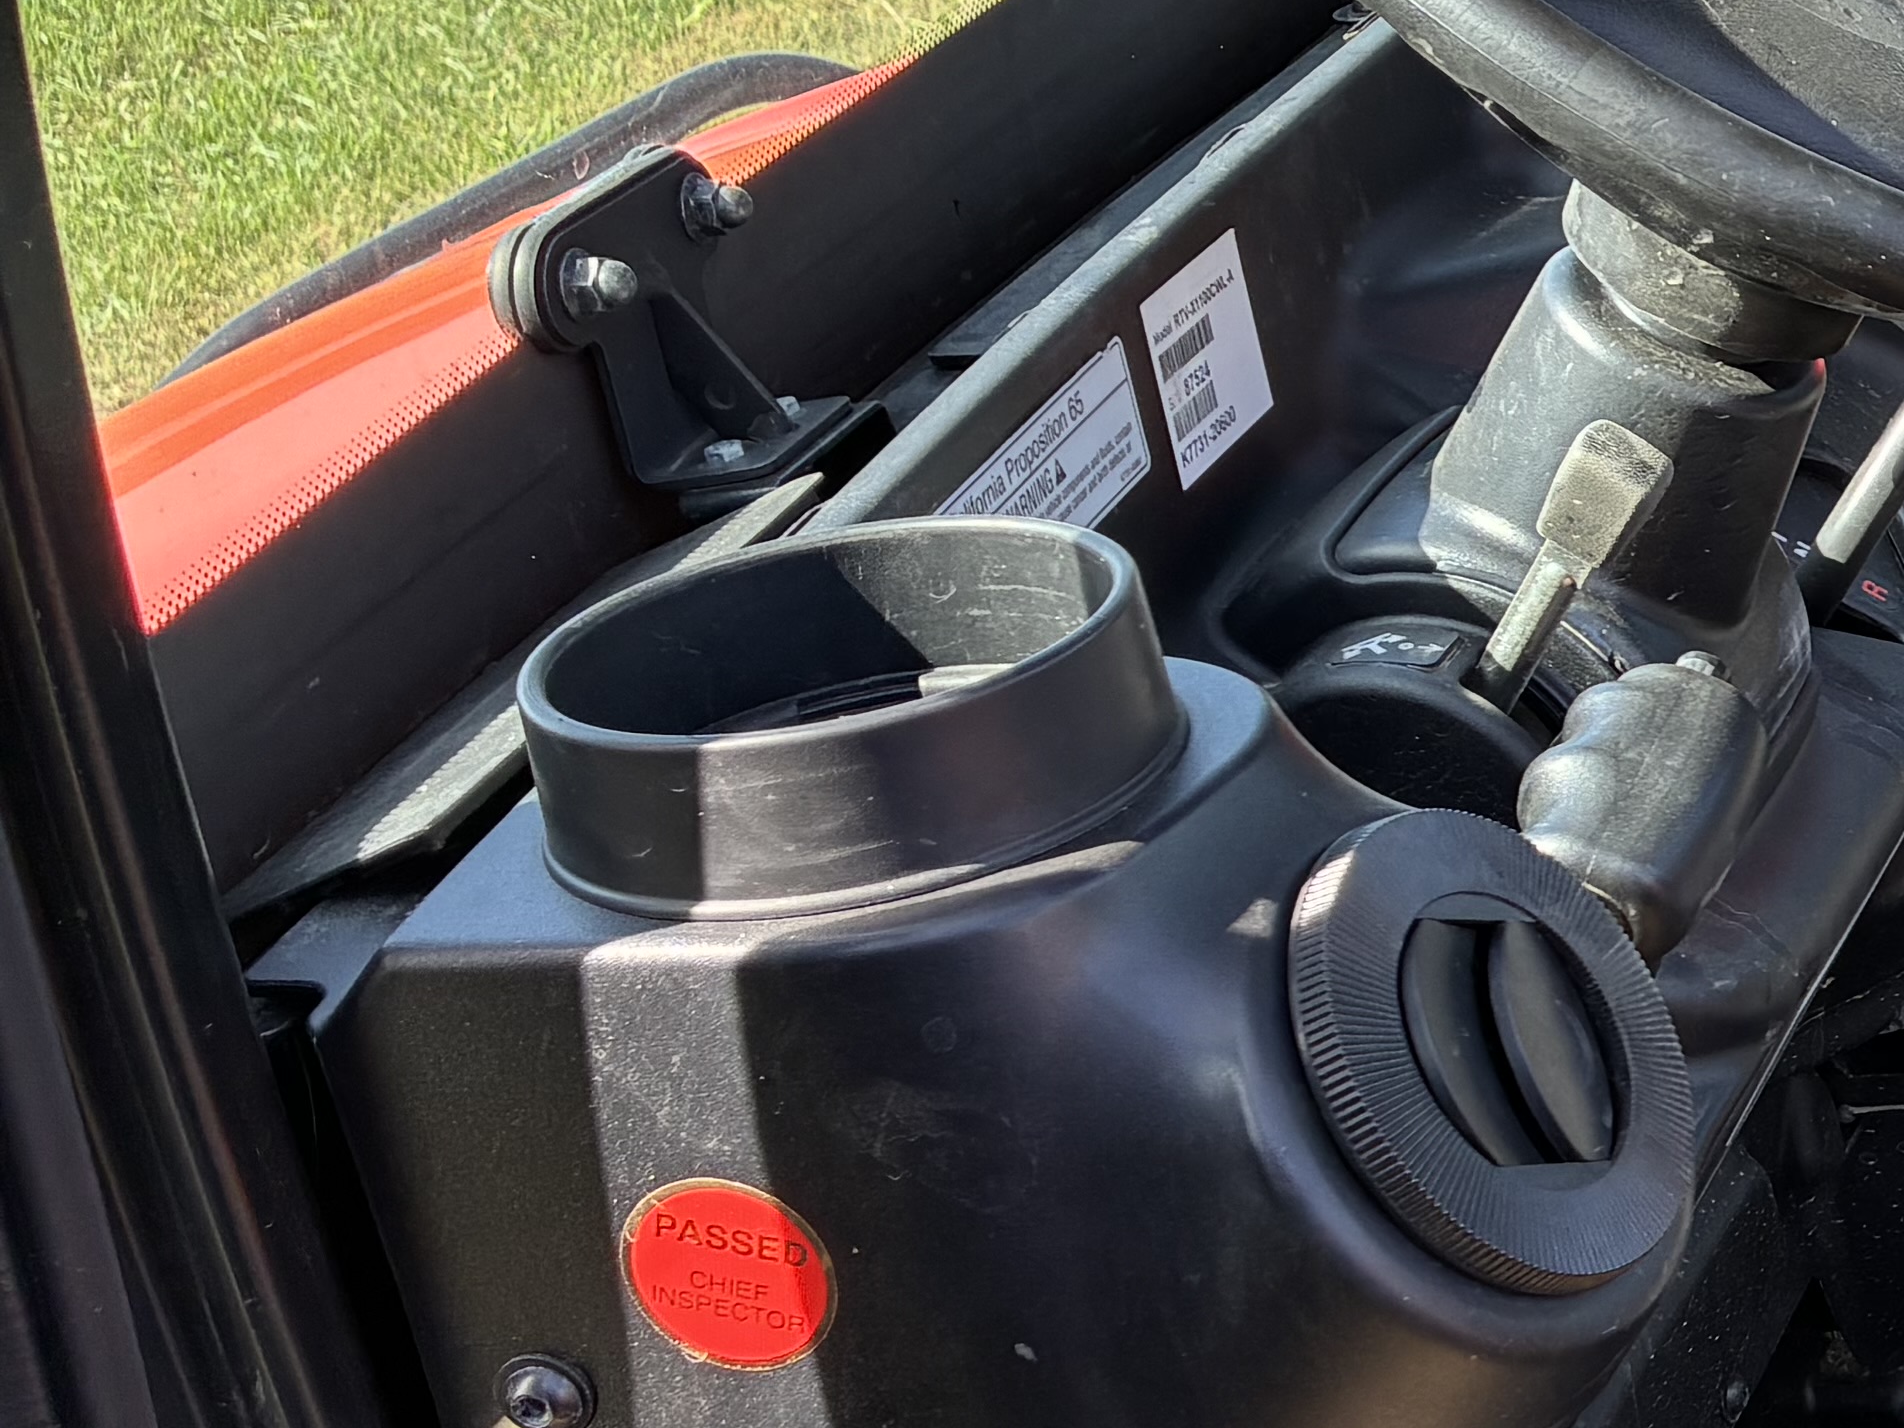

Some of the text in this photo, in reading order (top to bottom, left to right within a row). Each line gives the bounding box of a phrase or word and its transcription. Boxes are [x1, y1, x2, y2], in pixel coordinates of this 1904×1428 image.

[949, 390, 1084, 514] lifornia Proposition 65
[1004, 468, 1054, 516] ARNING
[1861, 579, 1888, 602] R
[654, 1212, 809, 1268] PASSED
[688, 1269, 770, 1299] CHIEF
[651, 1284, 806, 1334] INSPECTOR
